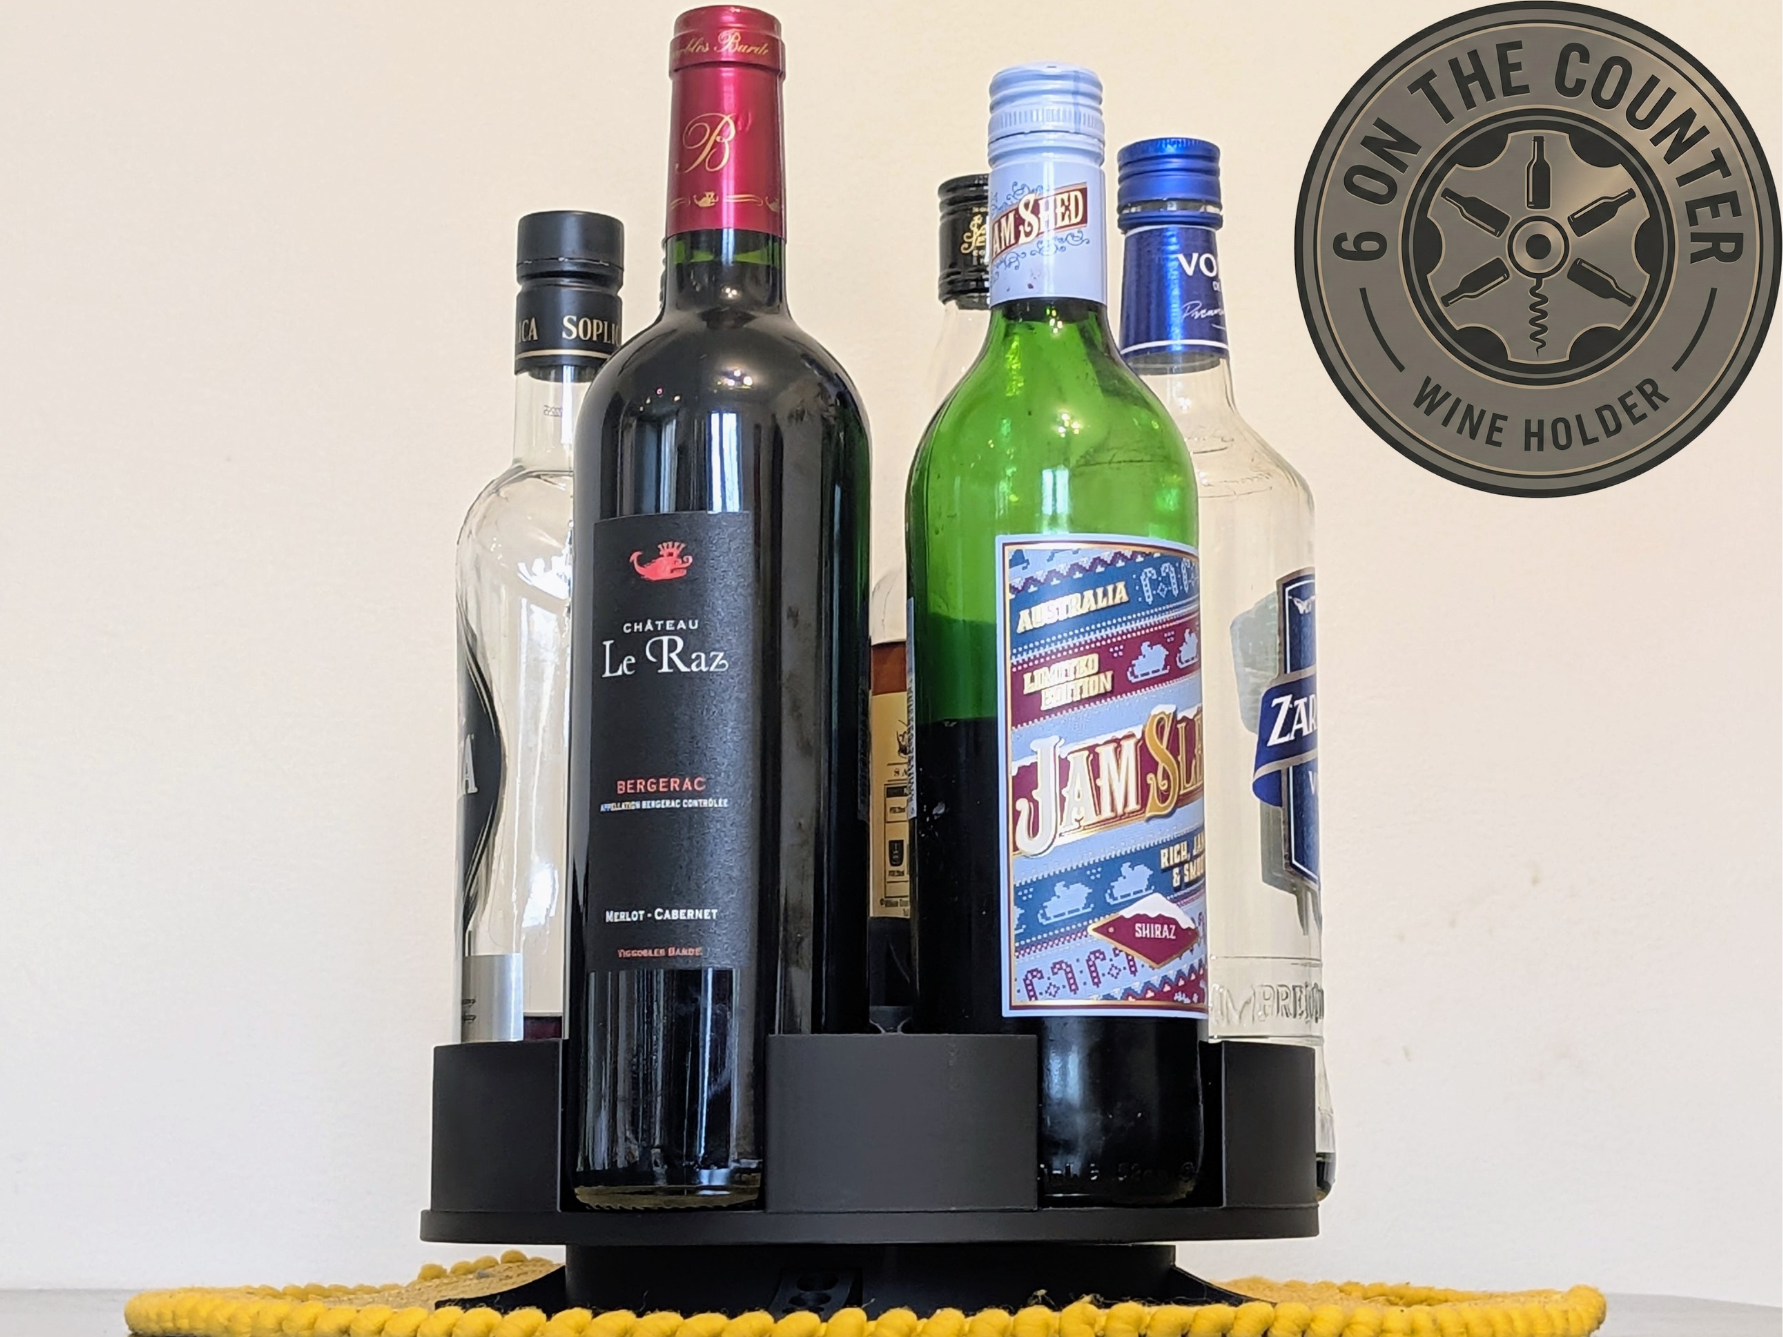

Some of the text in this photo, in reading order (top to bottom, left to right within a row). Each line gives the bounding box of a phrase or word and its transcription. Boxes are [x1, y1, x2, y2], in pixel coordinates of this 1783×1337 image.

[674, 113, 737, 174] B
[1019, 191, 1084, 245] SHED
[623, 619, 699, 633] CHÂTEAU
[1016, 581, 1129, 634] AUSTRALIA
[602, 635, 729, 678] Le Raz
[1023, 653, 1099, 695] LIMITED
[1040, 671, 1113, 711] EDITION
[616, 777, 706, 794] BERGERAC
[1015, 734, 1142, 857] JAM
[605, 910, 645, 922] MERLOT
[654, 908, 718, 920] CABERNET
[1135, 923, 1176, 939] SHIRAZ
